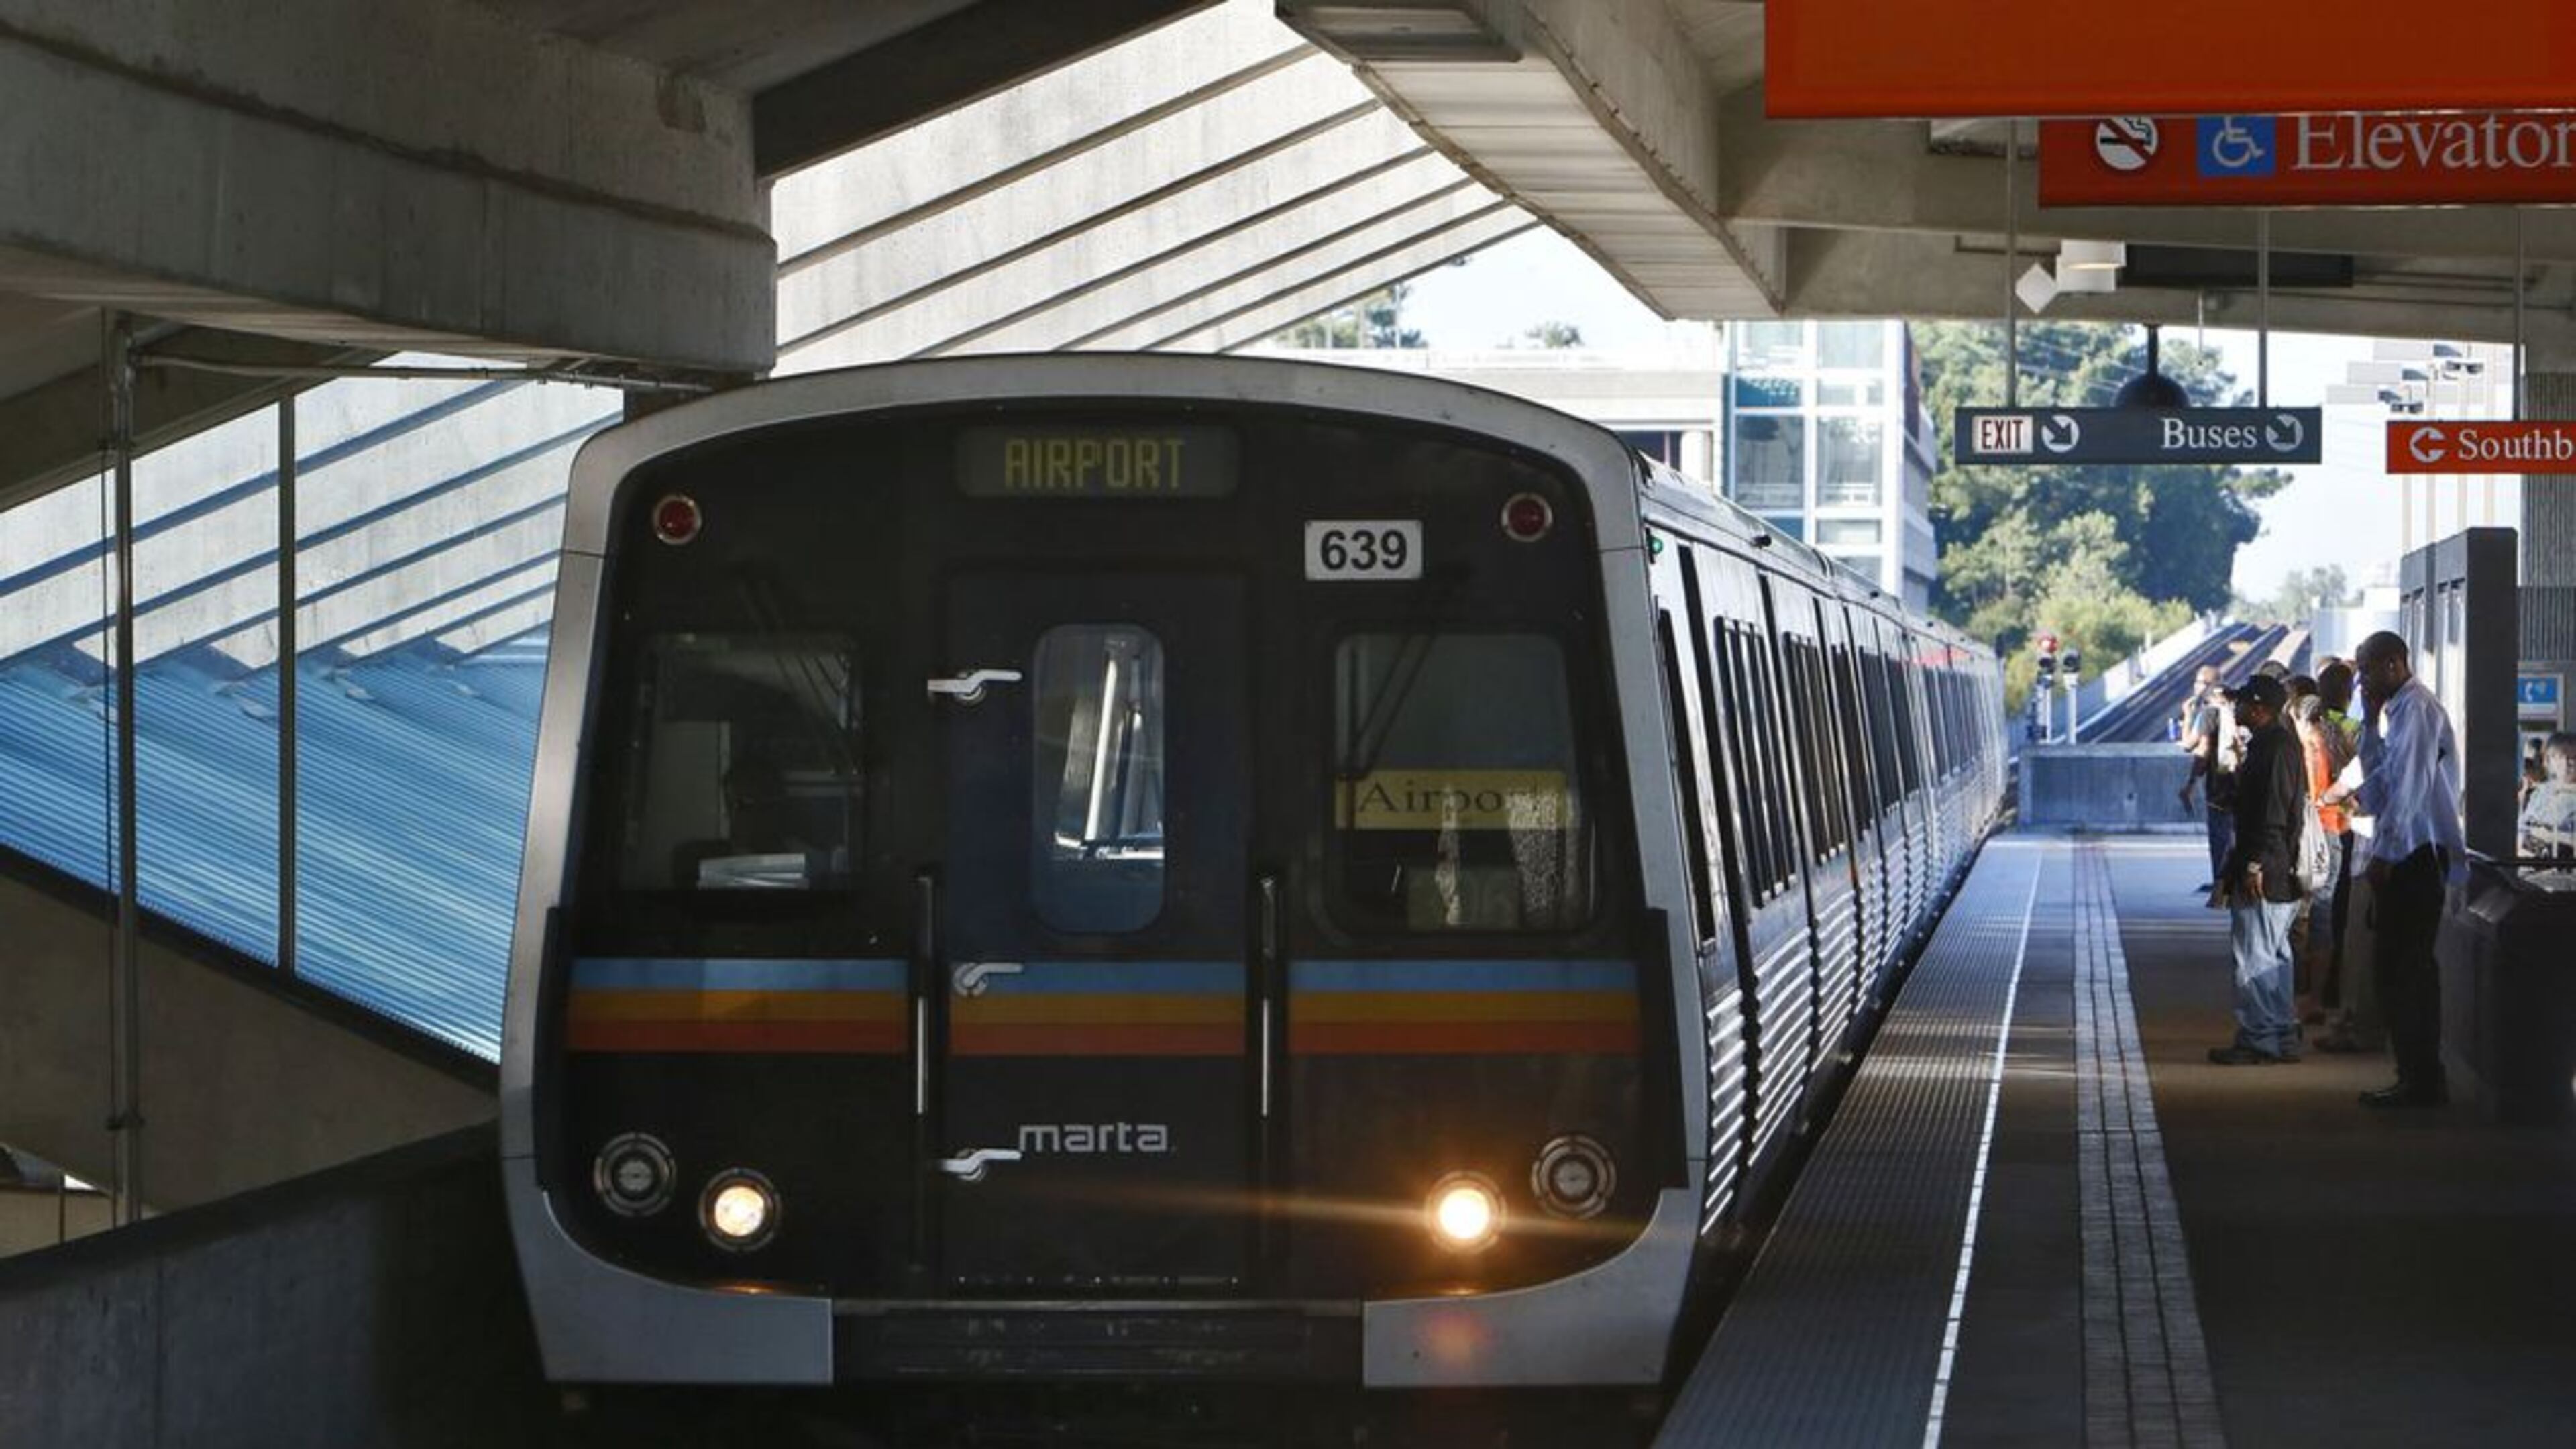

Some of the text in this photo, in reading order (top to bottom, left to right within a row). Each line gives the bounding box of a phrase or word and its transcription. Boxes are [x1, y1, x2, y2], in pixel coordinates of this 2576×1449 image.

[2292, 115, 2576, 170] Elevator
[1981, 417, 2257, 449] EXIT Buses
[2457, 428, 2573, 460] Southb
[1004, 437, 1187, 490] AIRPORT
[1319, 529, 1408, 572] 639
[1359, 778, 1550, 820] Airpo
[1018, 1121, 1168, 1152] marta
